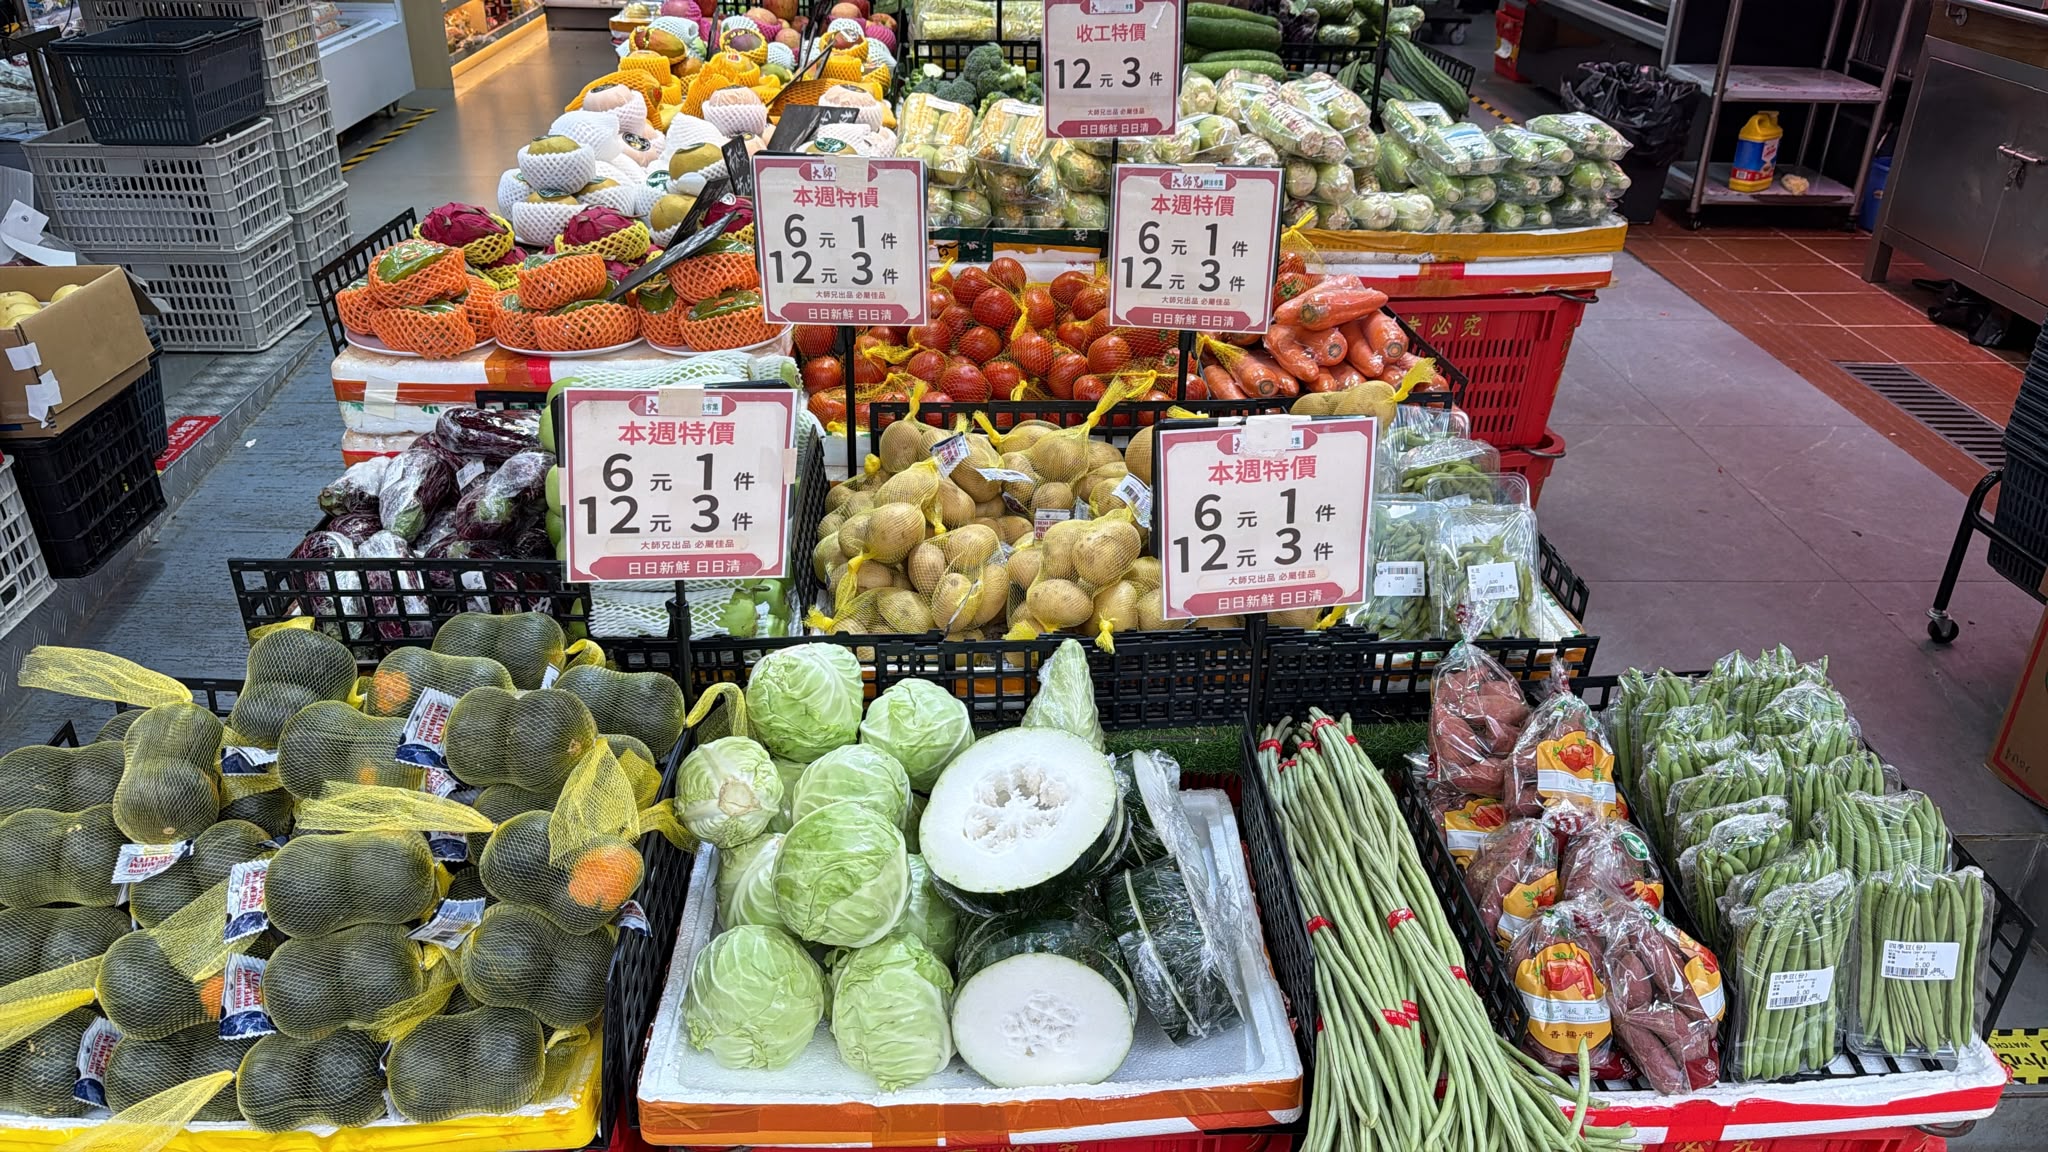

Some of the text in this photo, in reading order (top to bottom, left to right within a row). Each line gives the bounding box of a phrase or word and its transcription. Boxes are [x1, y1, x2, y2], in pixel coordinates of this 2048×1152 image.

[1076, 23, 1146, 43] 收工特價
[1054, 57, 1163, 89] 12 元 3 件
[1087, 107, 1144, 116] 大師兄出品 必屬佳品
[1080, 124, 1149, 135] 日日新鮮 日日清
[812, 164, 836, 180] 大師
[793, 186, 879, 208] 本週特價
[1151, 194, 1235, 216] 本週特價
[784, 214, 897, 249] 6 元 1 件
[1139, 221, 1248, 258] 6 元 1 件
[769, 251, 899, 285] 12 元 3 件
[1121, 256, 1245, 292] 12 元 3 件
[815, 291, 886, 299] 大師兄出品 必屬佳品
[1162, 296, 1231, 306] 大師兄出品 必屬佳品
[808, 308, 892, 321] 日日新鮮 日日清
[1152, 313, 1235, 327] 日日新鮮 日日清
[618, 420, 736, 446] 本週特價
[603, 453, 754, 493] 6 元 1 件
[1208, 455, 1317, 486] 本週特價
[579, 494, 753, 535] 12 元 3 件
[1194, 488, 1336, 532] 6 元 1 件
[640, 539, 734, 550] 大師兄出品 必屬佳品
[1173, 528, 1334, 573] 12 元 3 件
[628, 559, 741, 575] 日日新鮮 日日清
[1228, 570, 1316, 586] 大師兄出品 必屬佳品
[1218, 590, 1322, 611] 日日新鮮 日日清
[424, 704, 443, 742] PREMIUM
